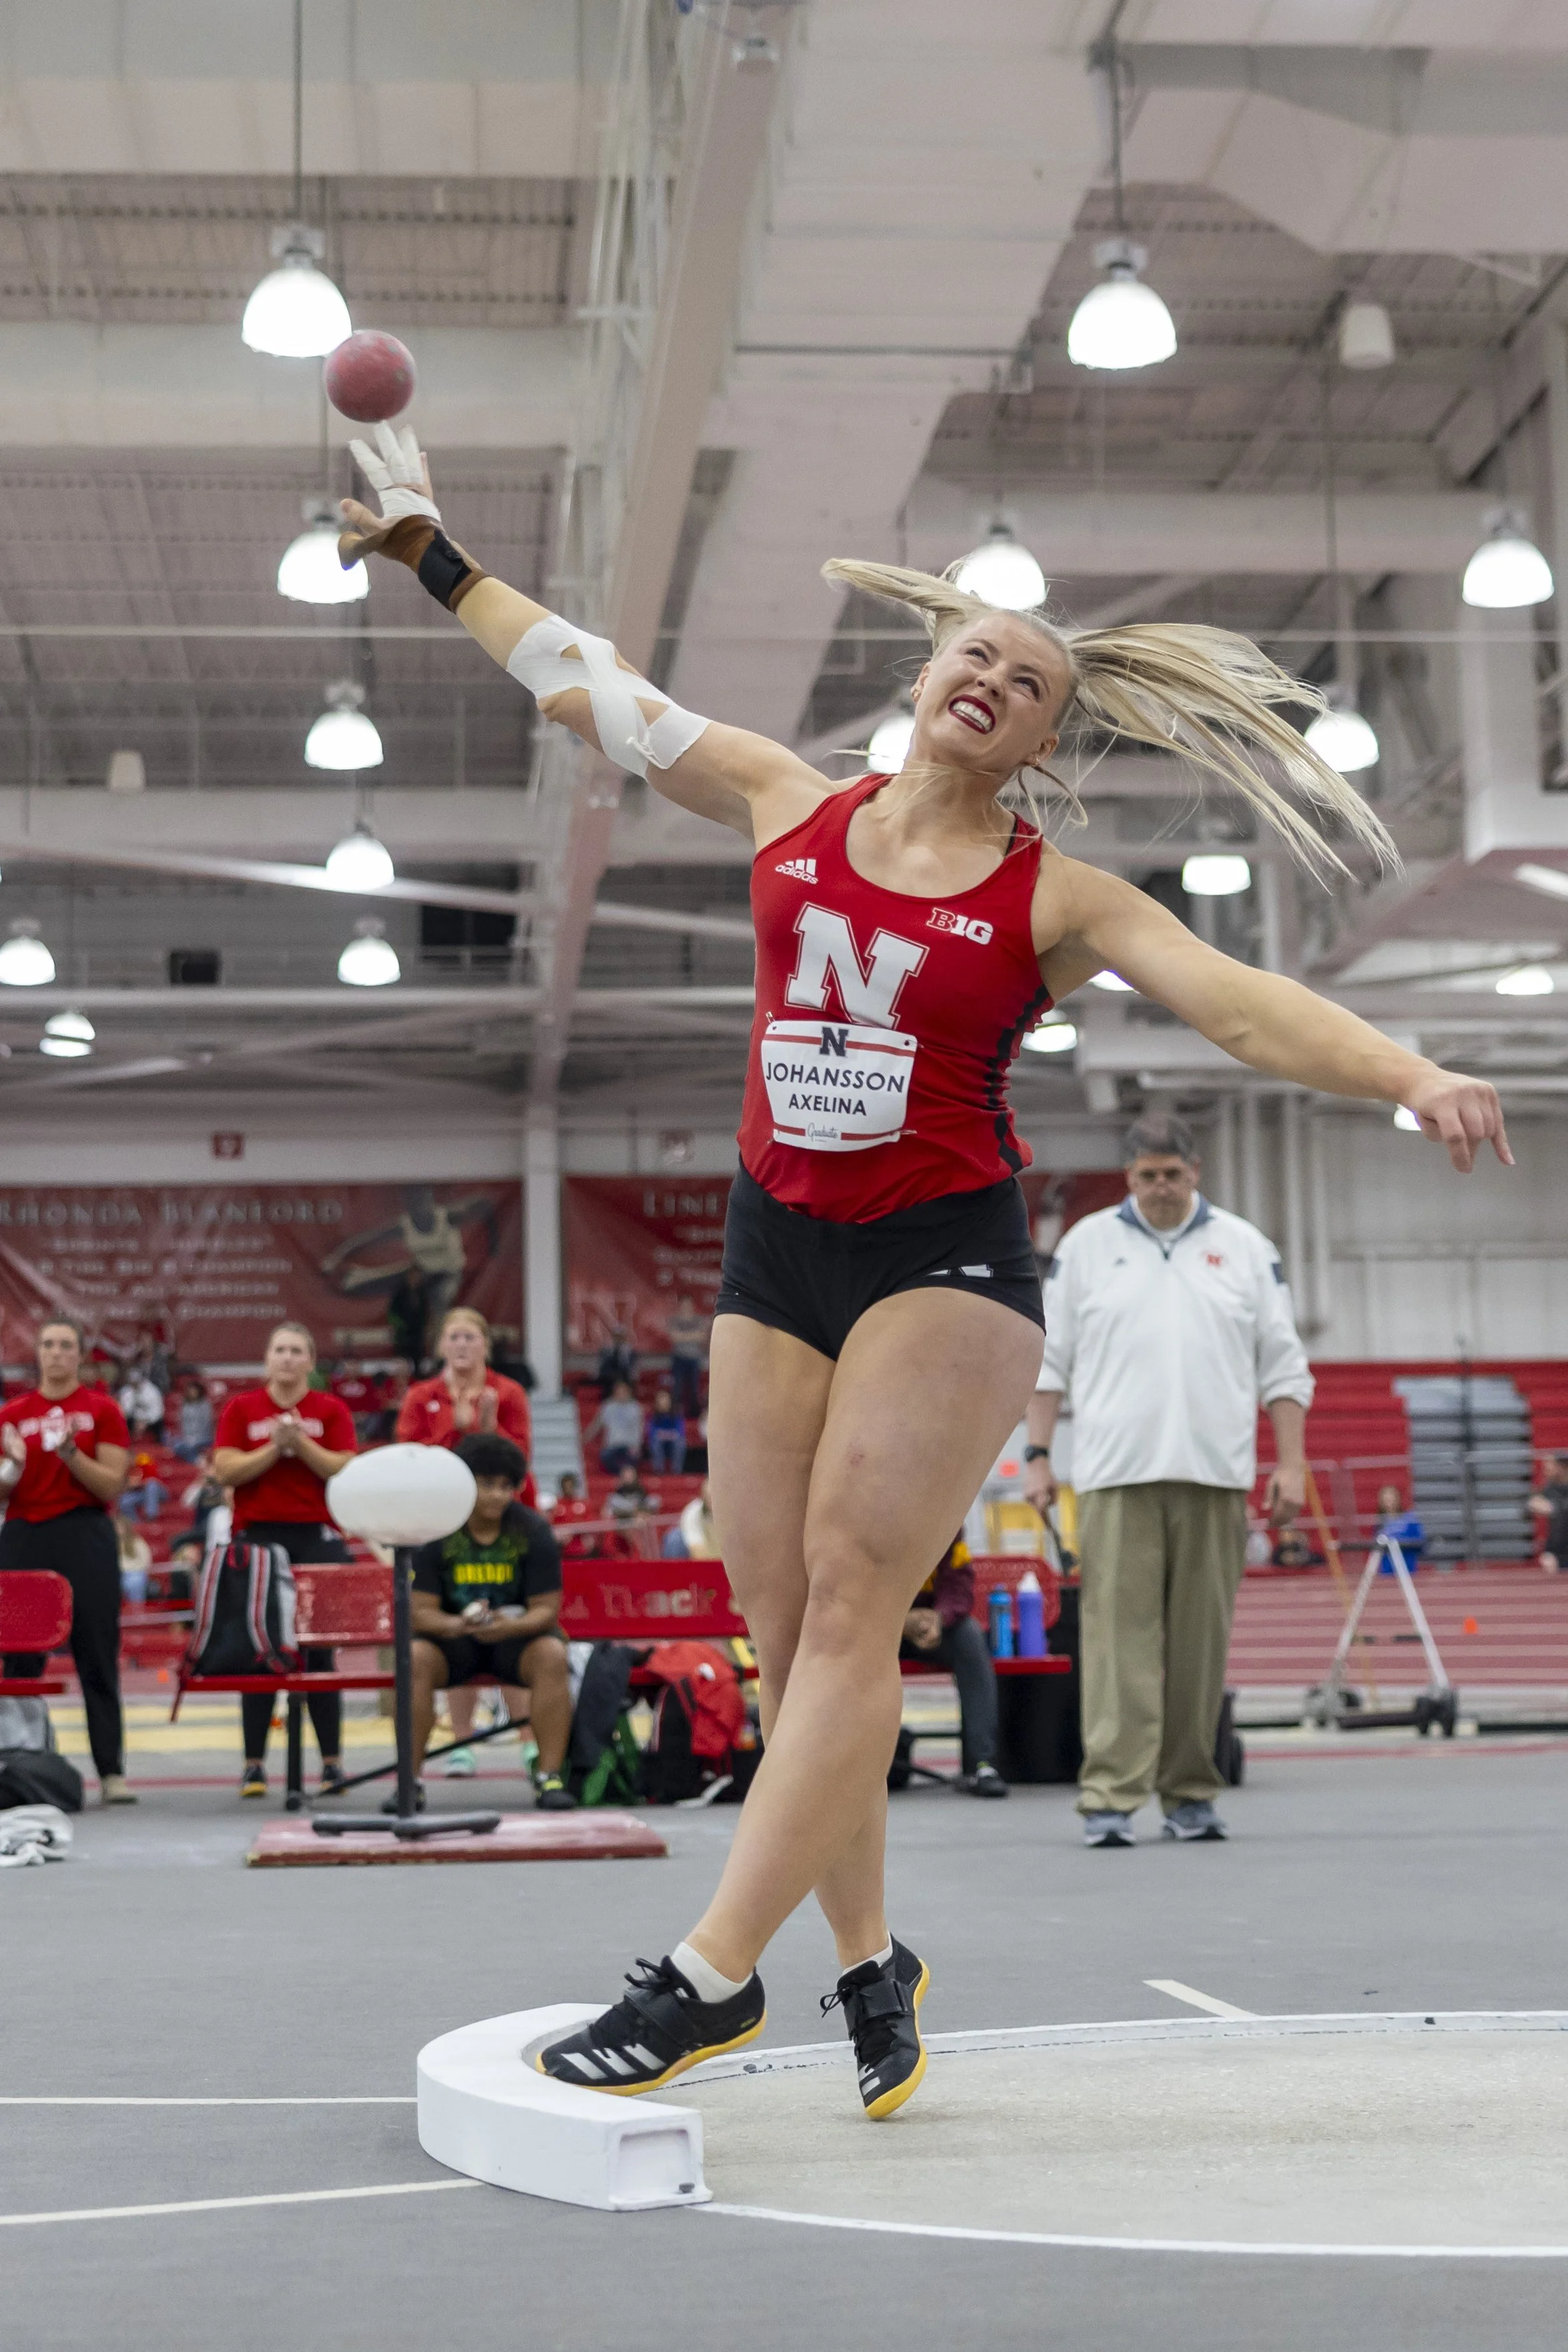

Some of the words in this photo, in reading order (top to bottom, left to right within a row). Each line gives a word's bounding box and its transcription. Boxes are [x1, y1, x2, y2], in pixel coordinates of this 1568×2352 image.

[775, 864, 819, 885] adidas
[784, 901, 930, 1030] N
[819, 1026, 849, 1058] N
[766, 1062, 905, 1094] JOHANSSON
[788, 1093, 867, 1116] AXELINA
